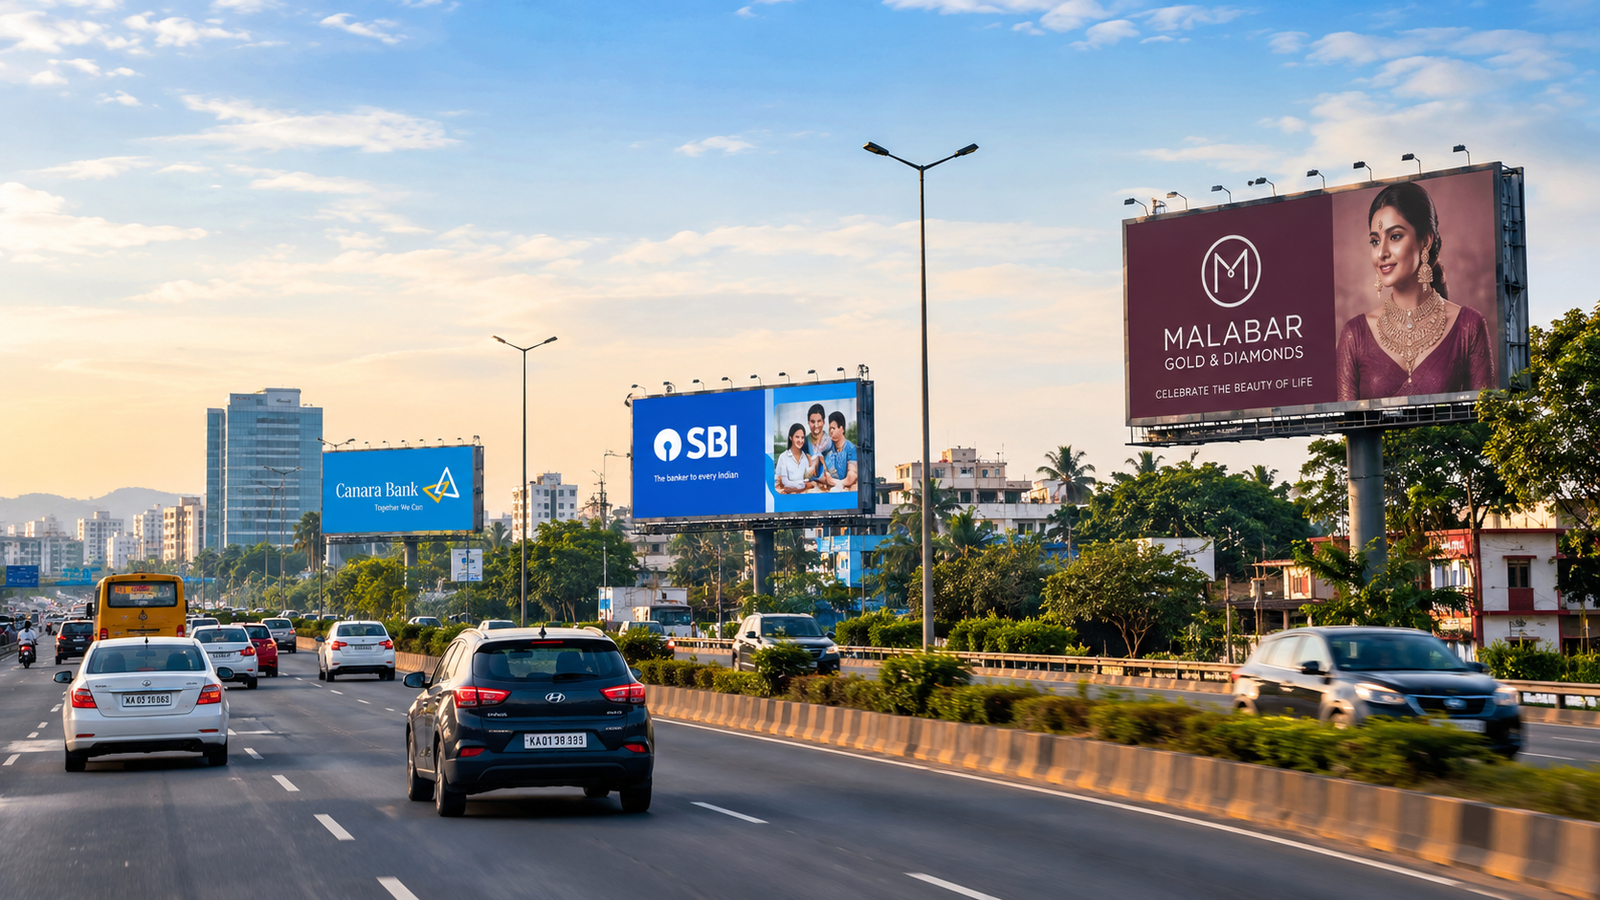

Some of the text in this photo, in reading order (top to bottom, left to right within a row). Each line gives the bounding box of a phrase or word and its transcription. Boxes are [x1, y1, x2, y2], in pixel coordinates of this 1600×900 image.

[1164, 314, 1303, 351] MALABAR
[1164, 345, 1304, 371] GOLD & DIAMONDS
[1155, 377, 1313, 400] CELEBRATE THE BEAUTY OF LIFE
[686, 425, 737, 459] SBI
[653, 474, 665, 482] The
[666, 473, 689, 482] banker
[698, 473, 717, 481] every
[718, 471, 739, 479] Indian
[336, 481, 418, 498] Canara Bank
[374, 503, 399, 513] Together
[400, 503, 410, 511] We
